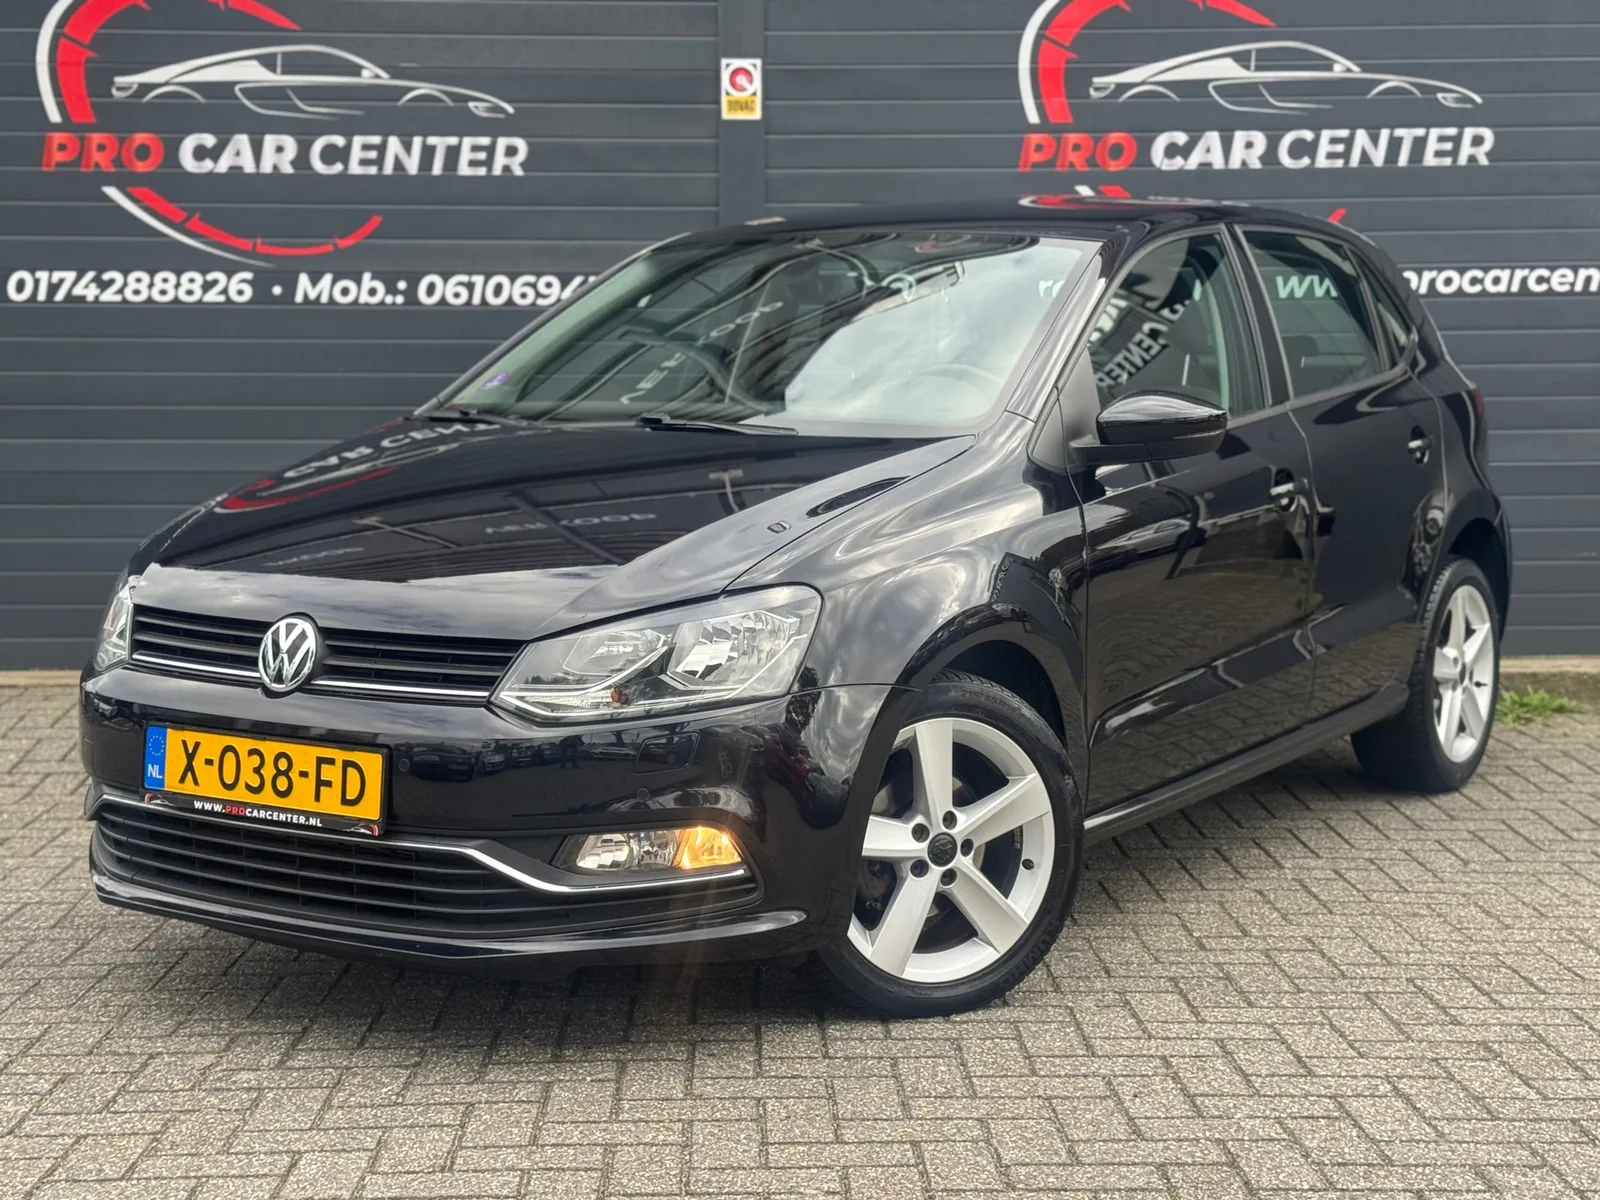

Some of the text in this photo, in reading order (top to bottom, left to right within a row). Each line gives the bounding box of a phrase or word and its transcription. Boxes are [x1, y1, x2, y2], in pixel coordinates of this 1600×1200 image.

[41, 132, 528, 177] PRO CAR CENTER
[1018, 126, 1495, 172] PRO CAR CENTER
[7, 269, 597, 306] 0174288826 Mob.: 061069
[148, 763, 162, 779] NL
[178, 738, 366, 807] X-038-FD
[193, 800, 323, 827] WWW.PROCARCENTER.NL
